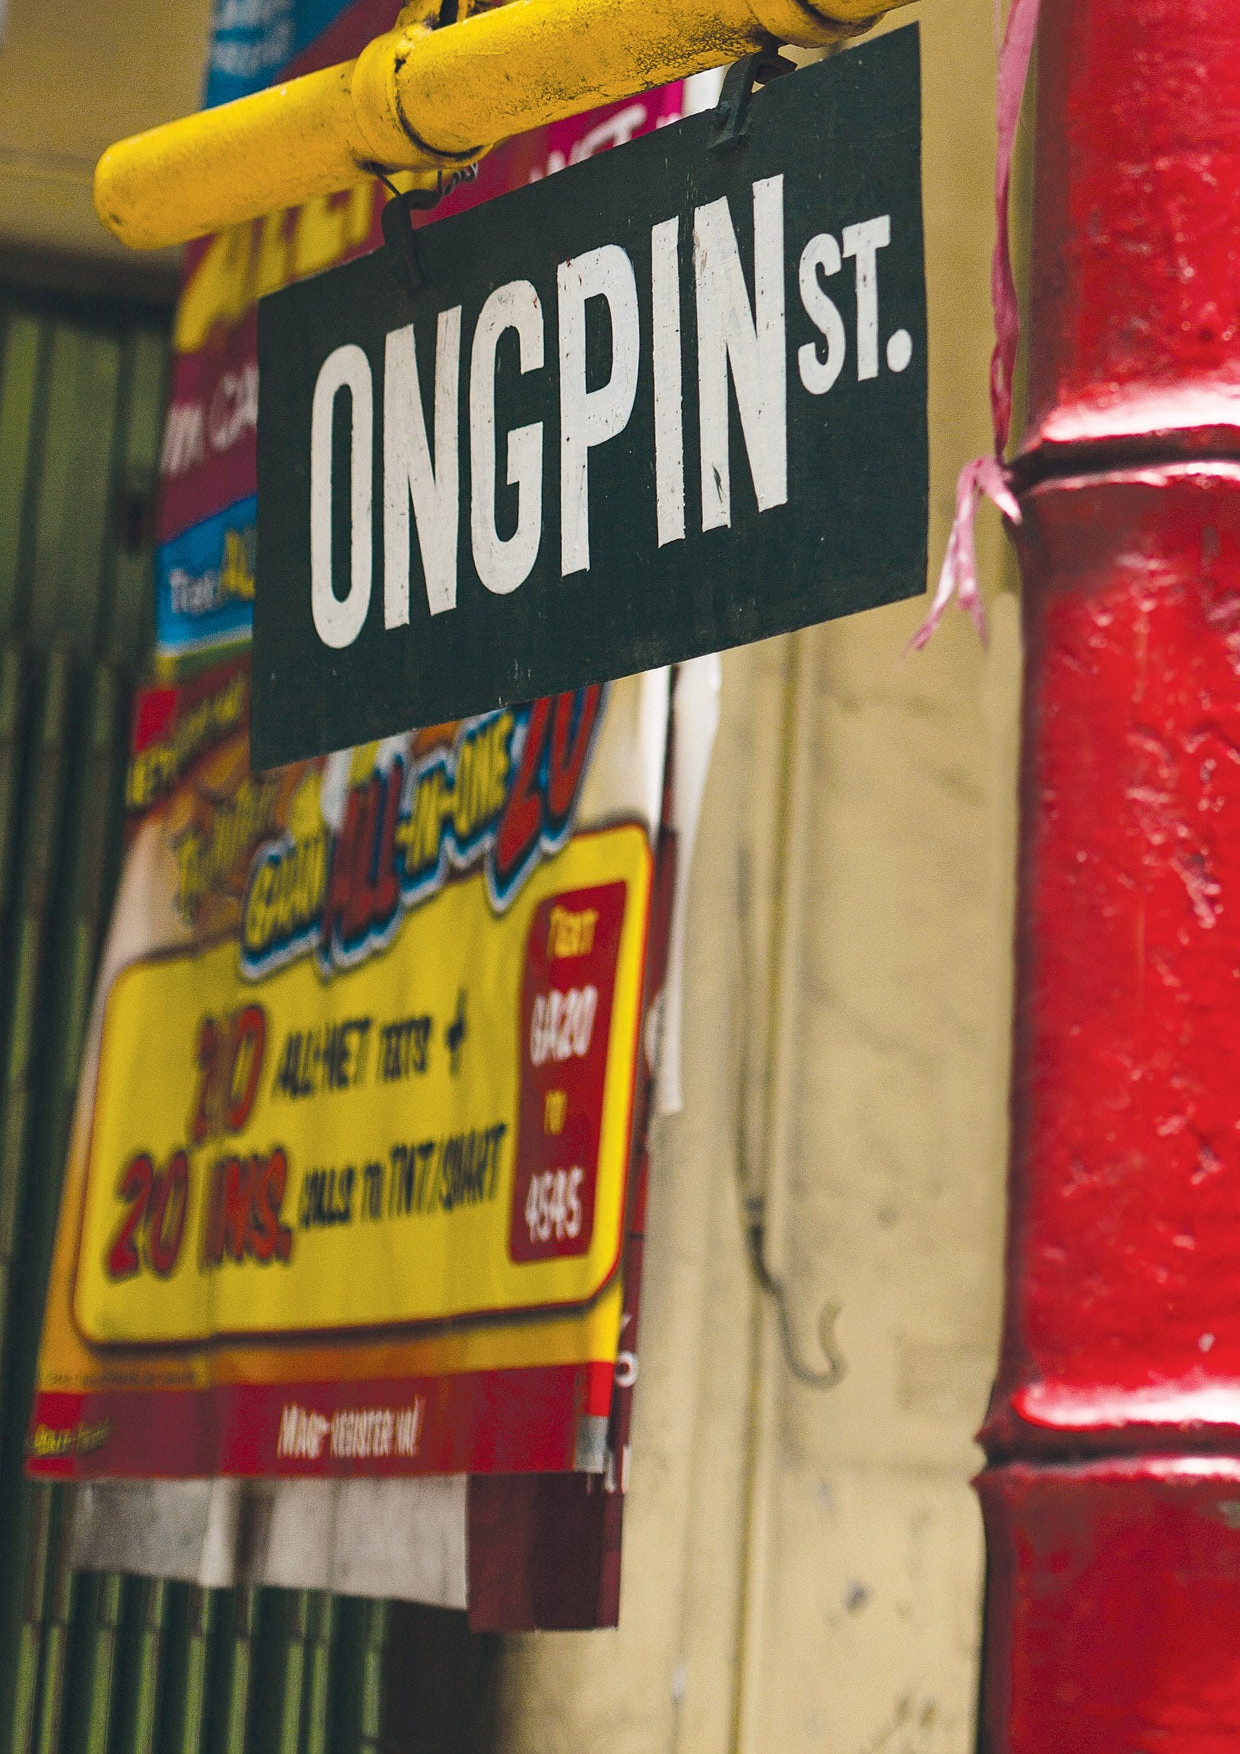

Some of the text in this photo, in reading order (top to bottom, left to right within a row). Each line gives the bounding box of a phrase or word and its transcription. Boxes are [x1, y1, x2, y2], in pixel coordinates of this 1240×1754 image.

[310, 174, 789, 649] ONGPIN
[798, 215, 913, 395] ST.
[107, 1148, 191, 1281] 20
